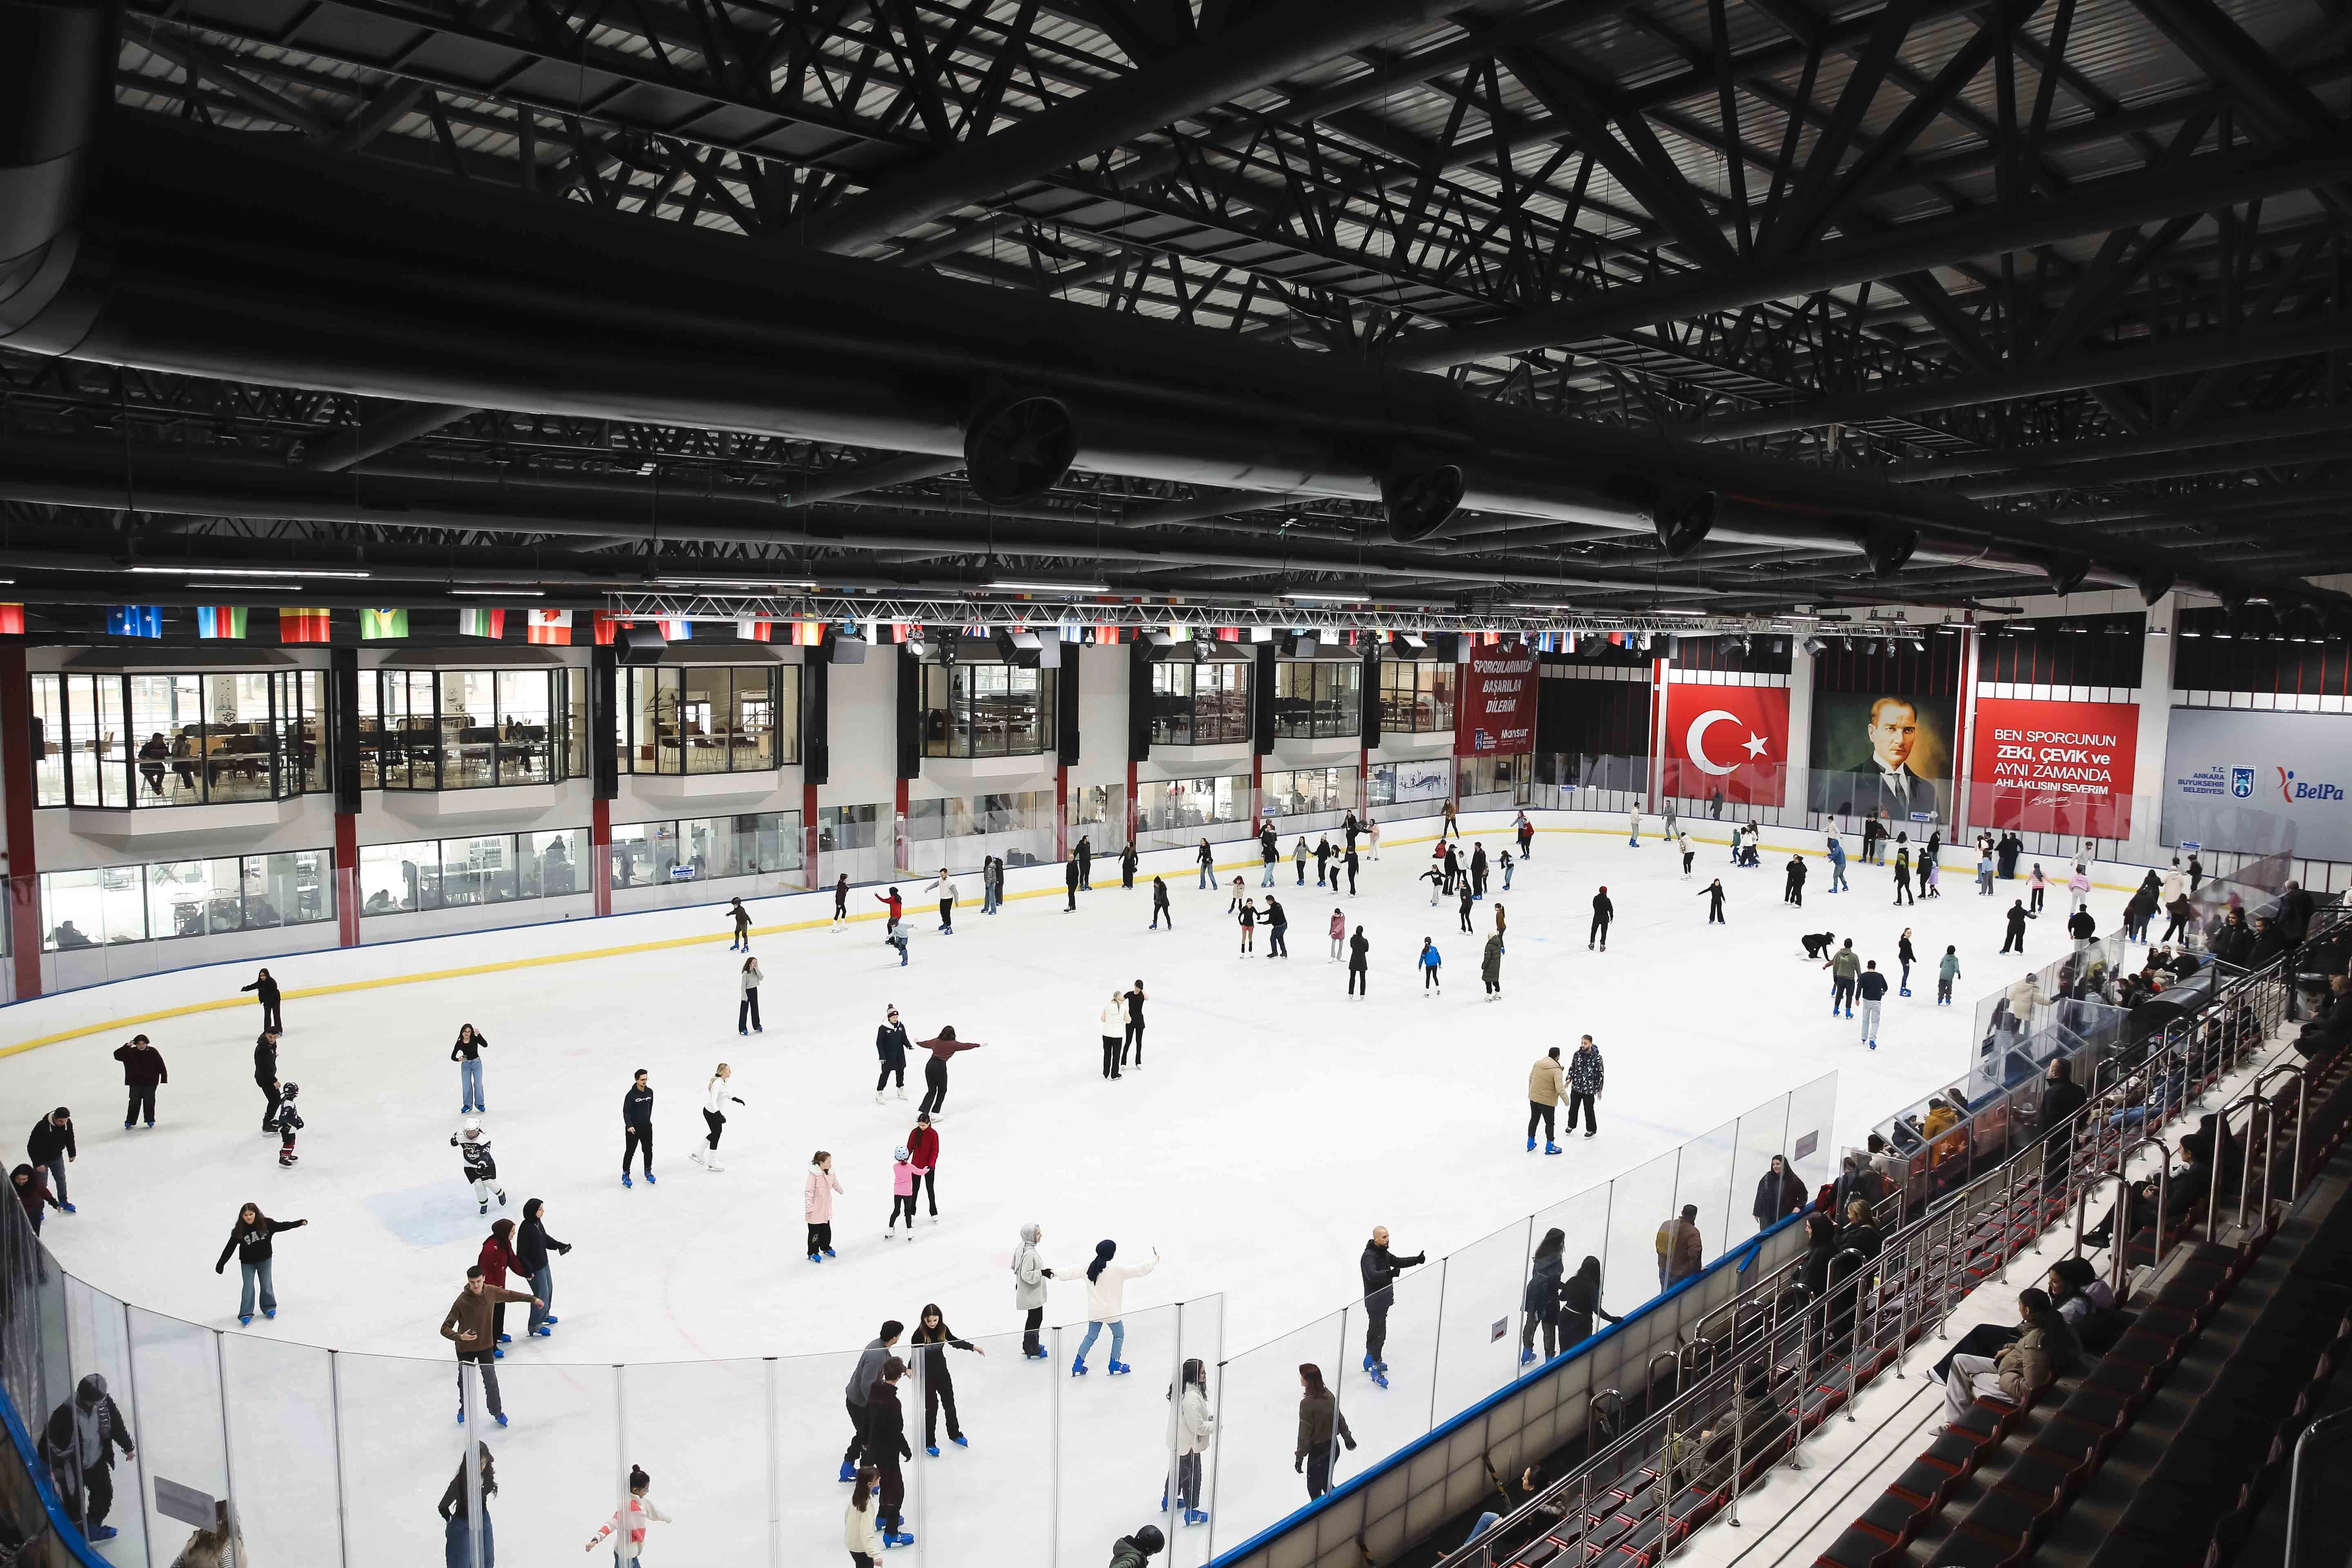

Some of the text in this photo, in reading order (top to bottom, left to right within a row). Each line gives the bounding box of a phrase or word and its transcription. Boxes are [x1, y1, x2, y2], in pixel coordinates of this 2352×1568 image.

[1483, 679, 1522, 695] BAŞARILAR
[1486, 697, 1516, 713] DİLERİM
[1501, 728, 1528, 739] Mansur
[1994, 729, 2116, 746] BEN SPORCUNUN
[2091, 754, 2110, 765] ve
[1994, 762, 2112, 782] AYNI ZAMANDA
[1995, 777, 2060, 791] AHLÂKLISINI
[2295, 782, 2344, 801] BelPa
